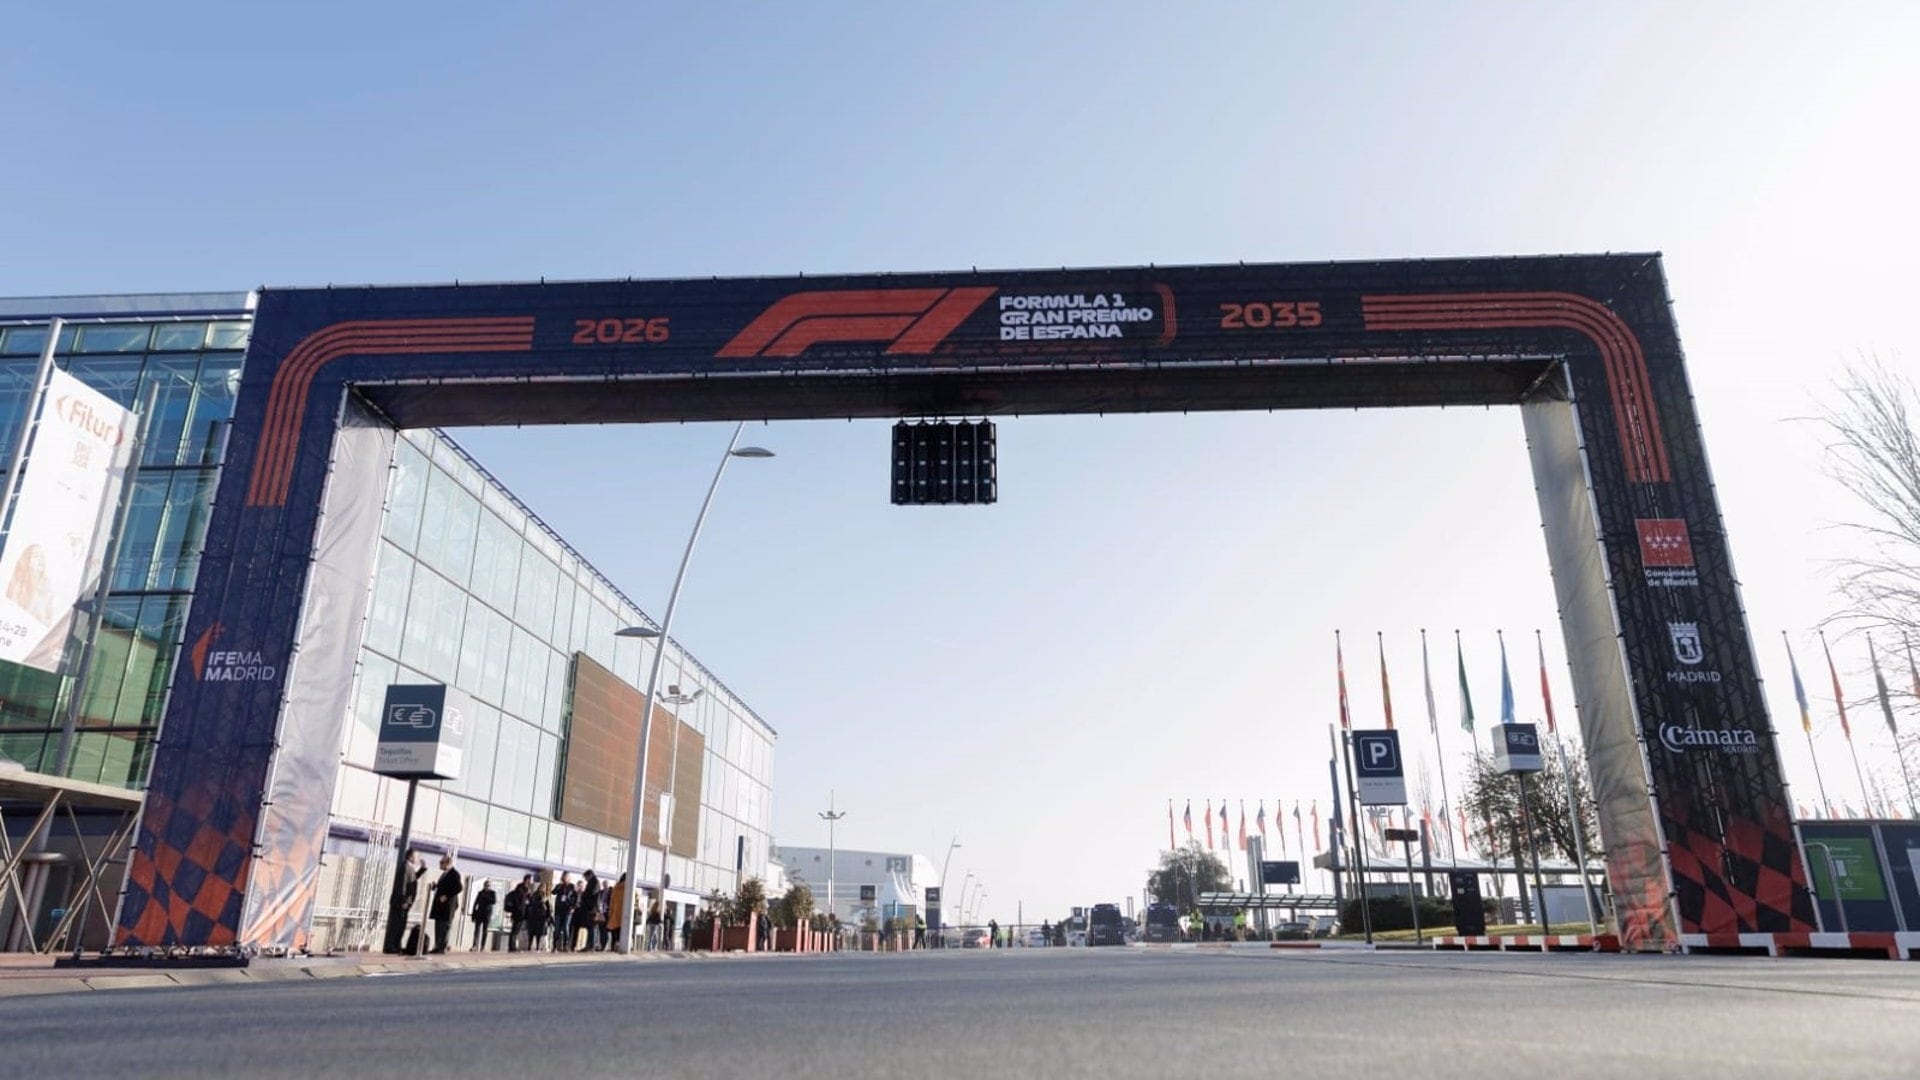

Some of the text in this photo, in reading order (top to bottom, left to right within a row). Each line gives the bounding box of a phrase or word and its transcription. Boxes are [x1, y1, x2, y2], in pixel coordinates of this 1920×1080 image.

[1000, 293, 1126, 310] FORMULA 1
[1000, 307, 1153, 325] GRAN PREMIO
[1220, 301, 1323, 329] 2035
[572, 317, 670, 344] 2026
[1000, 323, 1124, 341] DE ESPAÑA
[68, 399, 114, 442] Fitur
[1648, 577, 1699, 587] de Madrid
[208, 651, 262, 666] IFEMA
[204, 666, 276, 682] MADRID
[1666, 671, 1722, 682] MADRID
[1369, 742, 1388, 765] P
